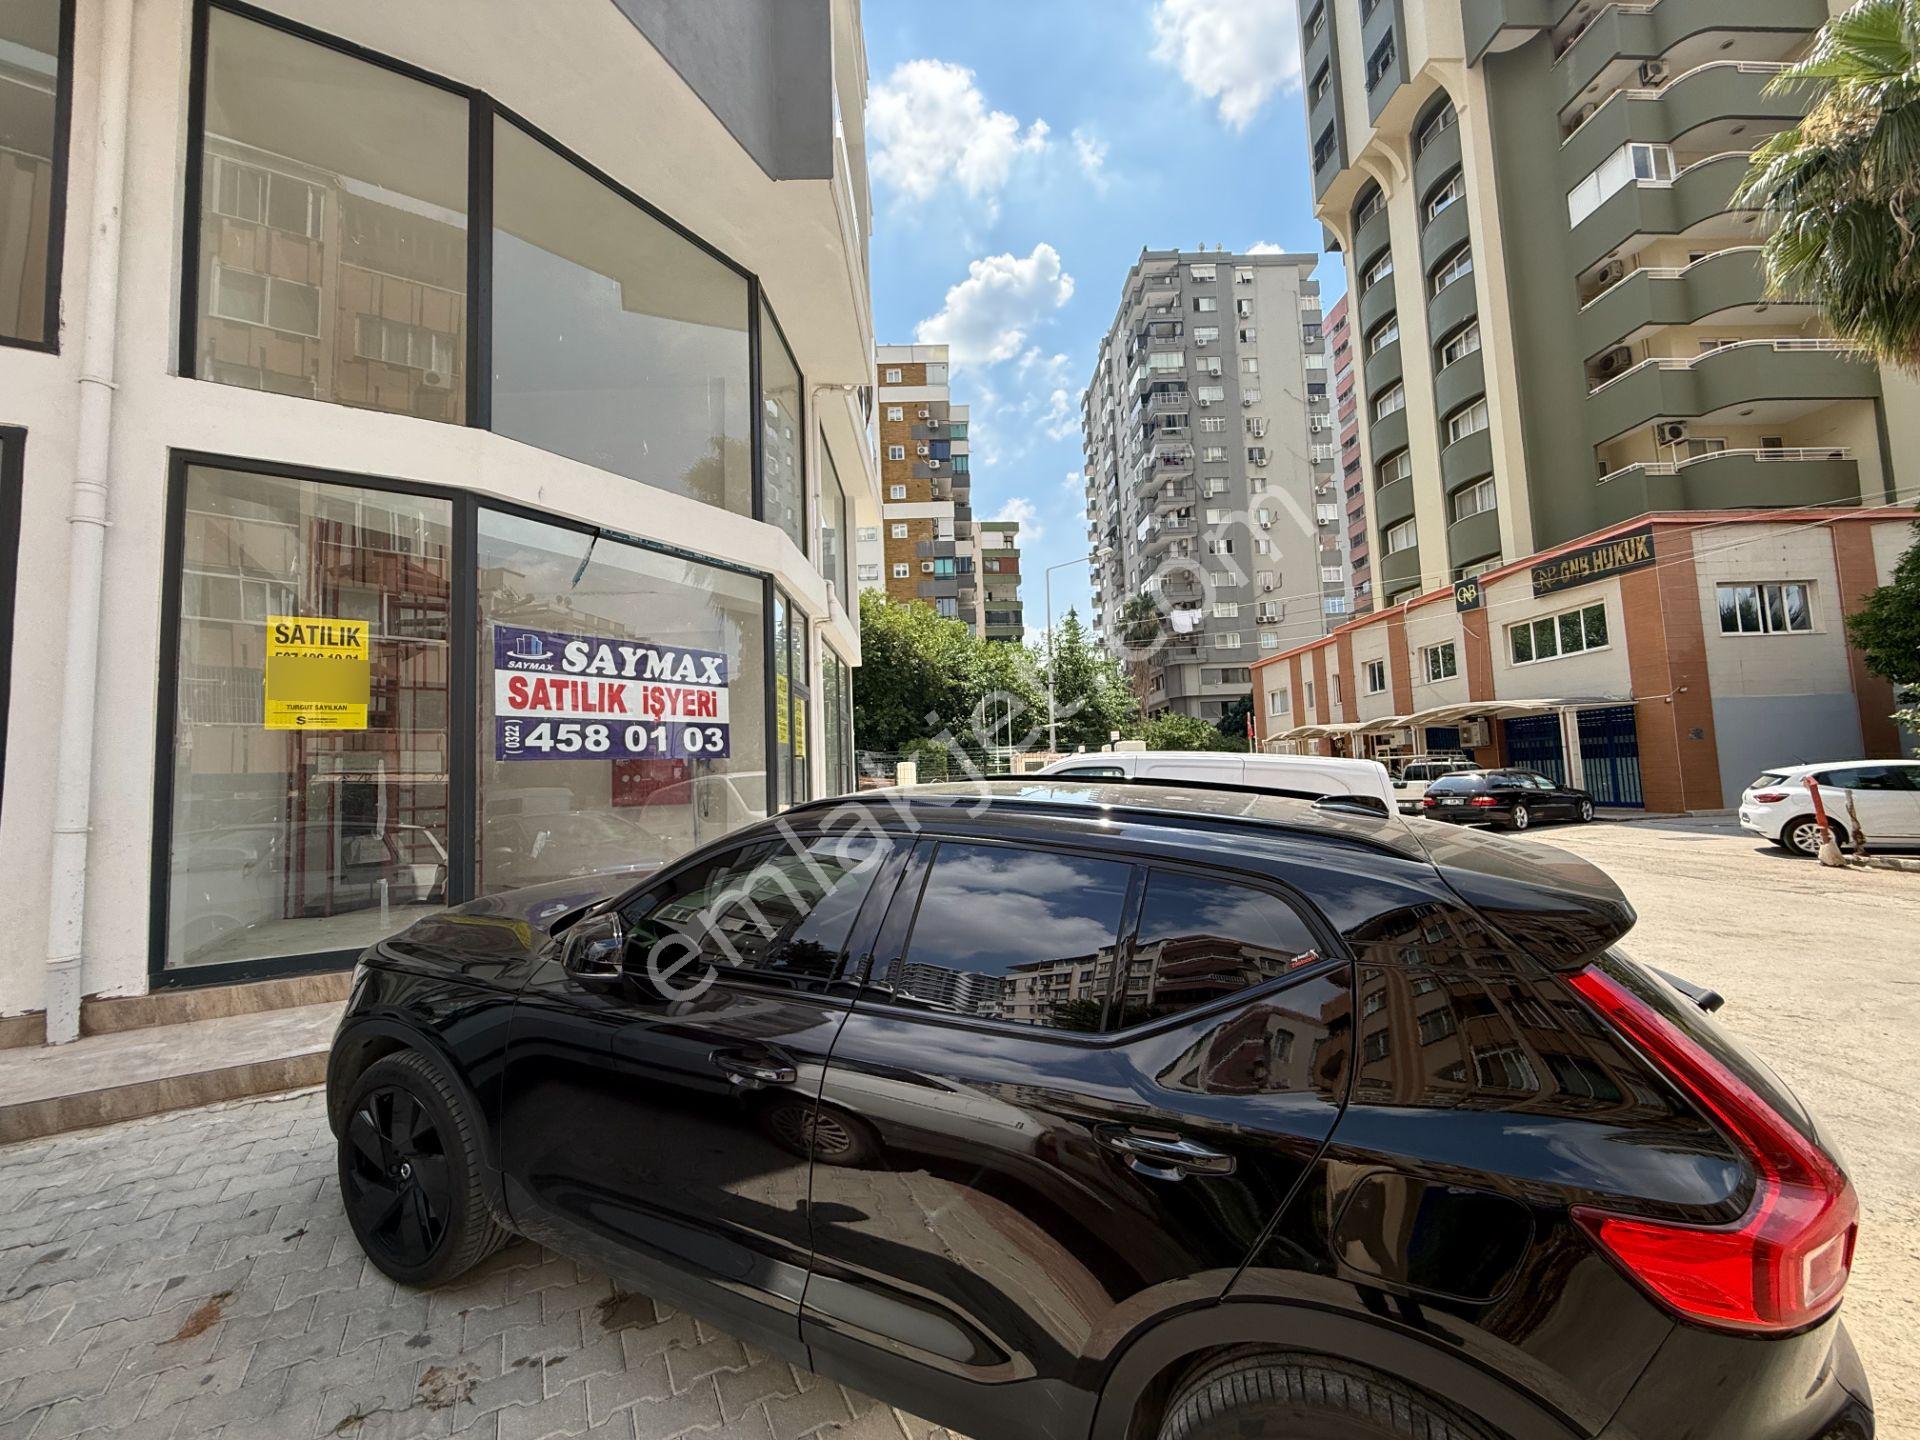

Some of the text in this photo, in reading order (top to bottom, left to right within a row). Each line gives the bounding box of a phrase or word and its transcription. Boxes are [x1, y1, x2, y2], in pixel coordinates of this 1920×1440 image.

[1592, 535, 1650, 573] HUKUK
[275, 623, 361, 648] SATILIK
[507, 660, 553, 672] SAYMAX
[562, 640, 723, 685] SAYMAX
[508, 675, 718, 723] SATILIK İŞYERİ
[505, 719, 524, 754] (0322)
[524, 722, 724, 753] 458 01 03
